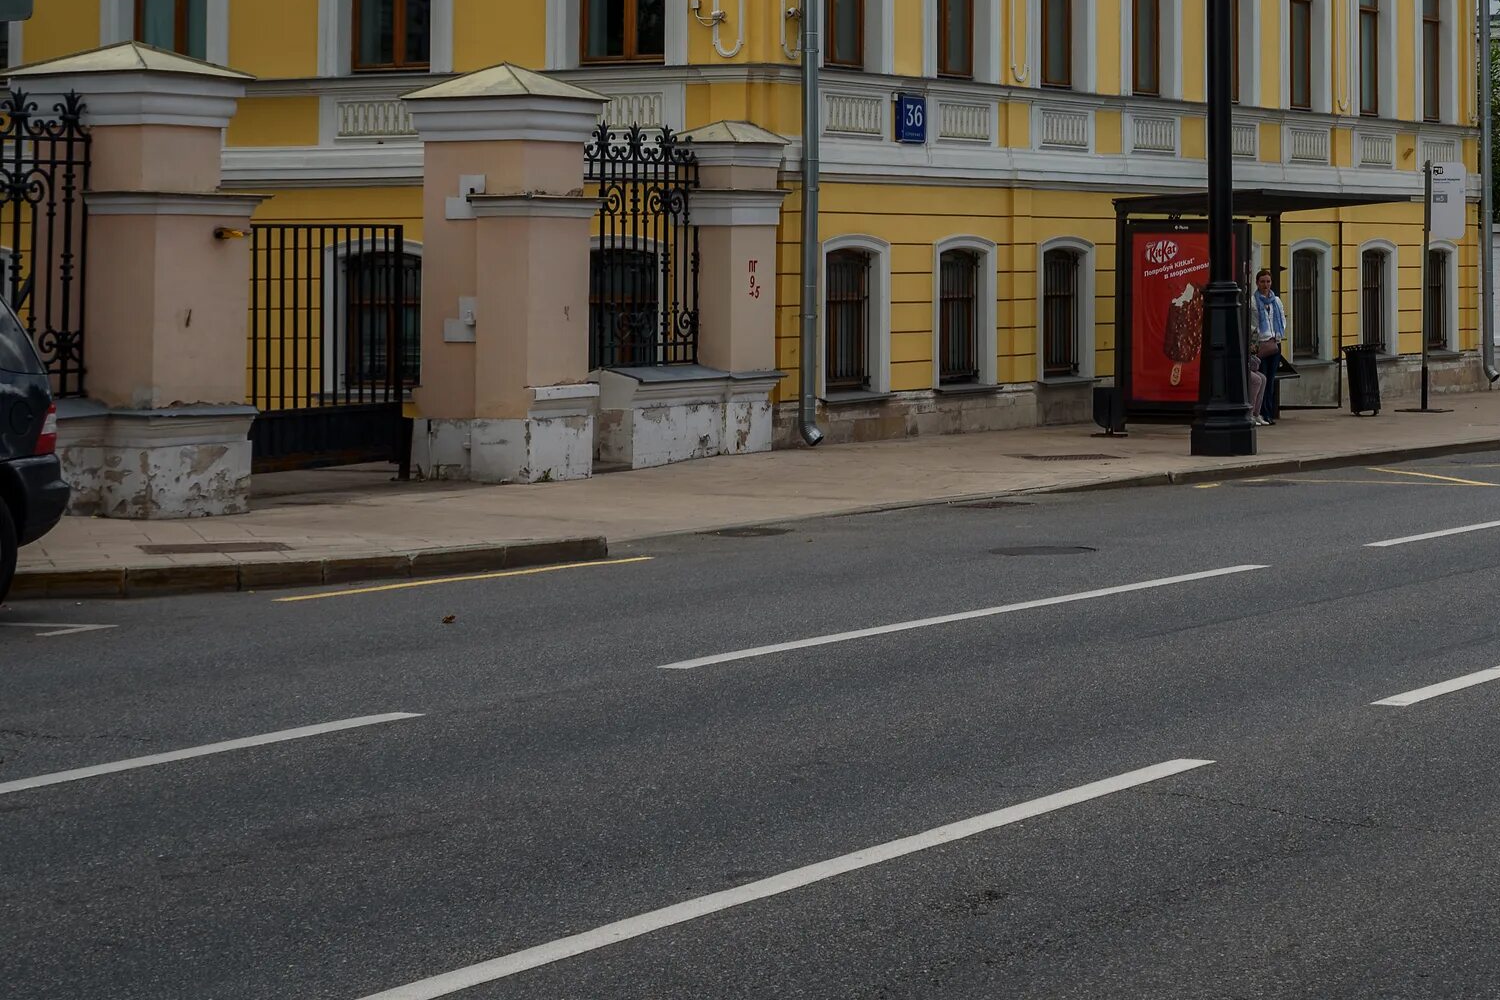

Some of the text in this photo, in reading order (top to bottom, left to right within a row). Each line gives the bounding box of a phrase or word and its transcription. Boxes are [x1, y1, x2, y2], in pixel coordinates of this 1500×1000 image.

[906, 104, 923, 127] 36
[1148, 240, 1178, 264] KitKat
[1144, 262, 1173, 277] Попробуй
[750, 275, 755, 288] 9
[755, 286, 760, 299] 5
